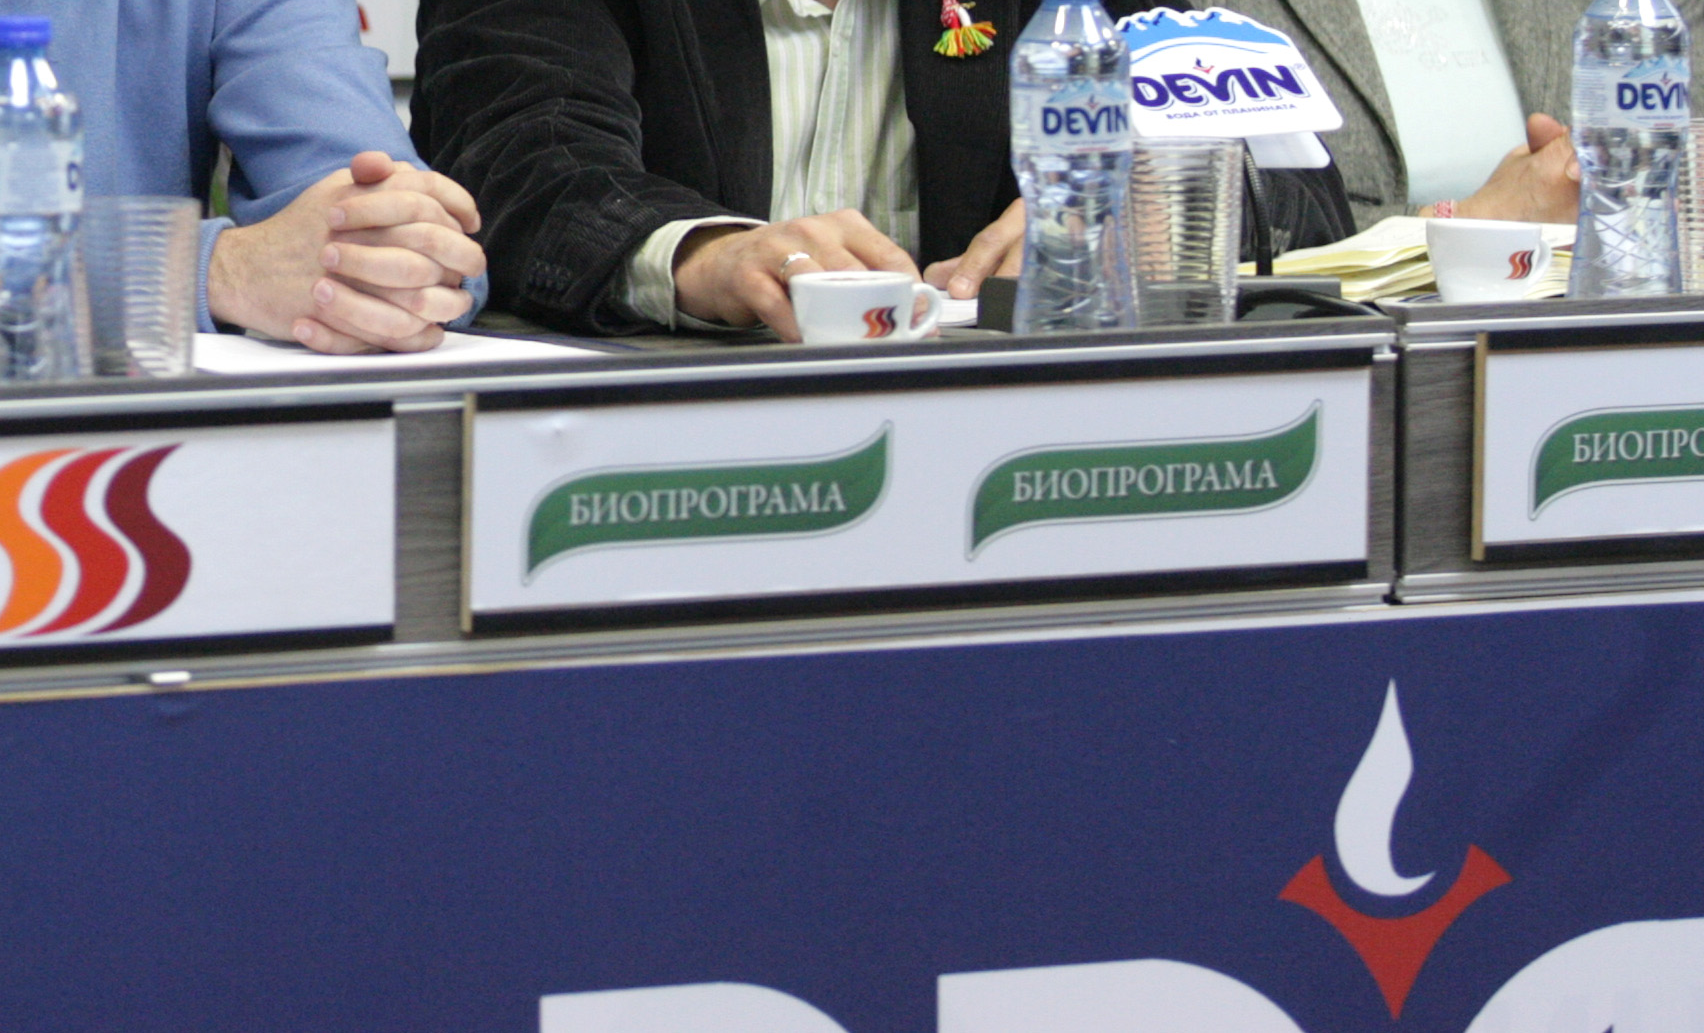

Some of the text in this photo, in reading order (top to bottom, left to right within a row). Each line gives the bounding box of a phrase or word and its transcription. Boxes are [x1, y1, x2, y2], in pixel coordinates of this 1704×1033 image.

[1132, 65, 1308, 110] DEVIN
[1166, 103, 1298, 120] ВОДА ОТ ПЛАНИНАТА
[1010, 455, 1279, 503] БИОПРОГРАМА
[568, 479, 848, 528] БИОПРОГРАМА
